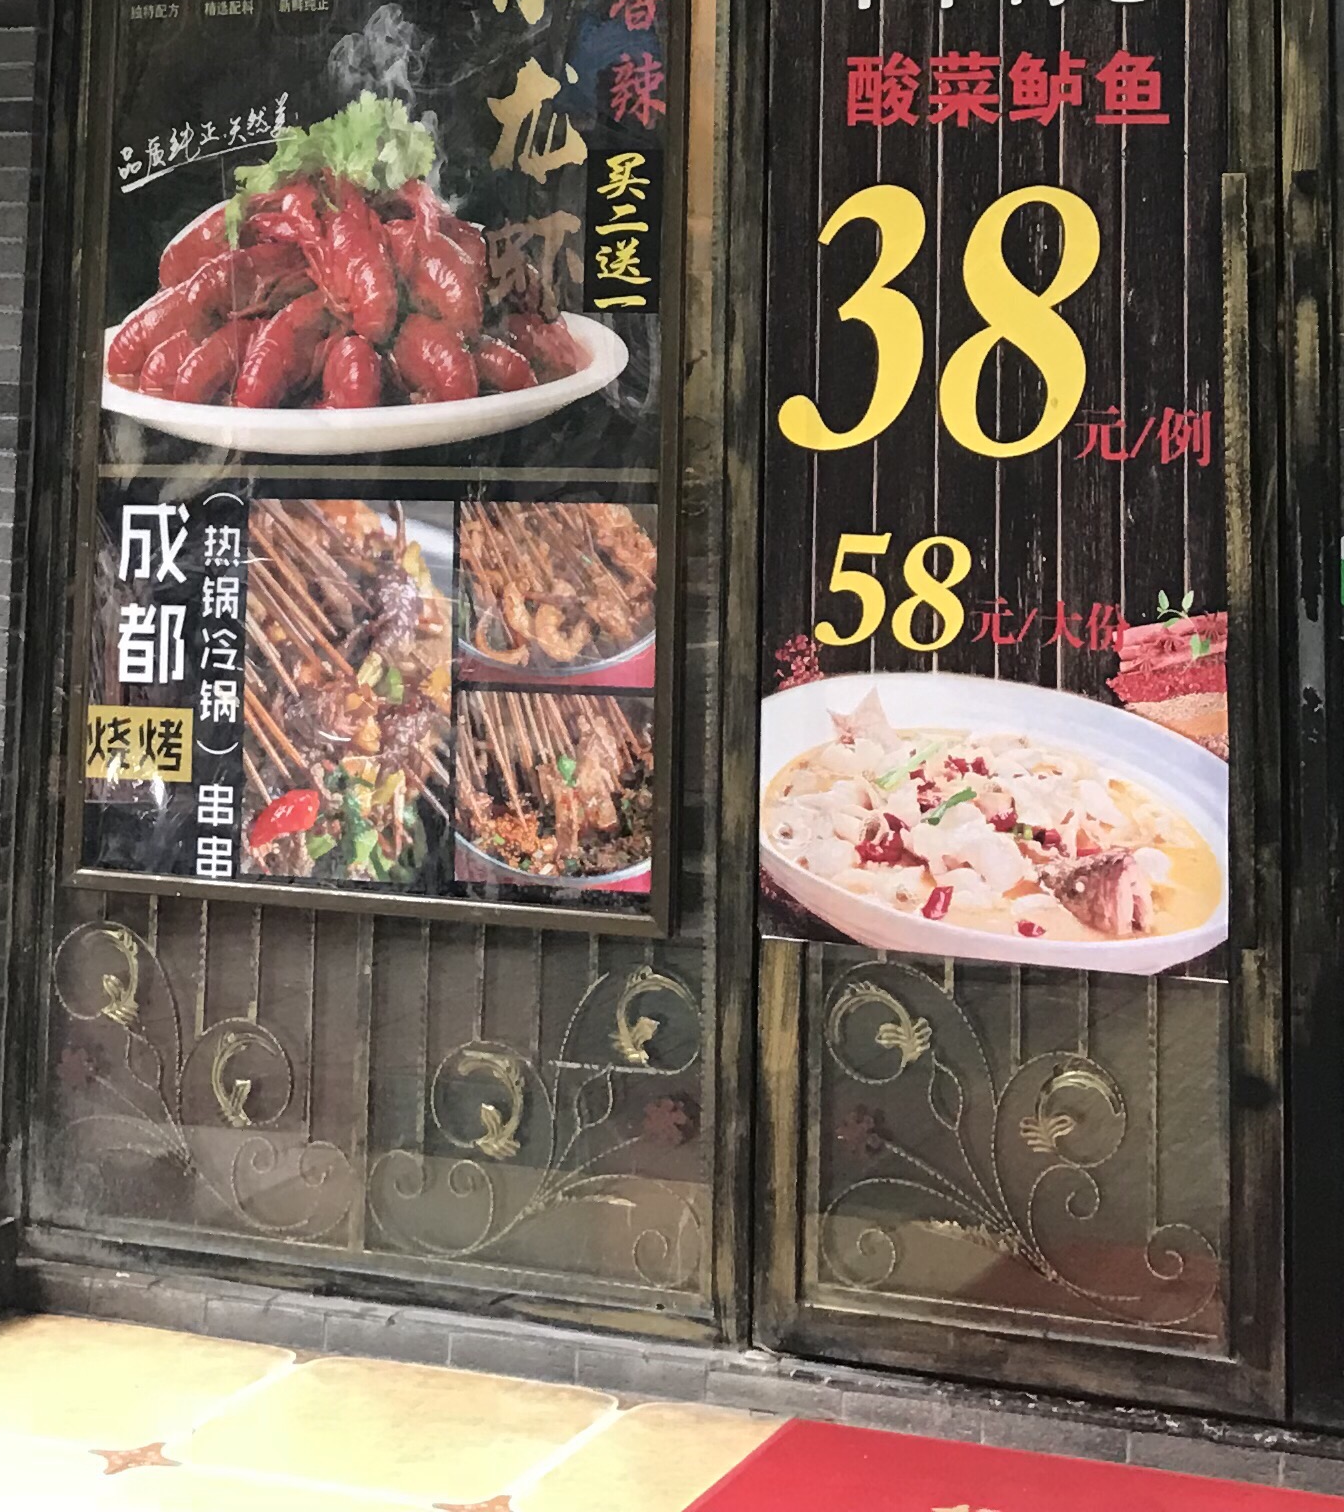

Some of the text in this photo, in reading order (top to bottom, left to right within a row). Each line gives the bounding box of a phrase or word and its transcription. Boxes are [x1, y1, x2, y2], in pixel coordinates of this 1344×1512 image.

[846, 51, 1171, 128] 酸菜鲈鱼
[594, 152, 652, 309] 买二送一
[778, 184, 1212, 468] 38 元/例
[118, 502, 189, 685] 成都
[815, 533, 972, 652] 58
[87, 717, 184, 774] 烧烤
